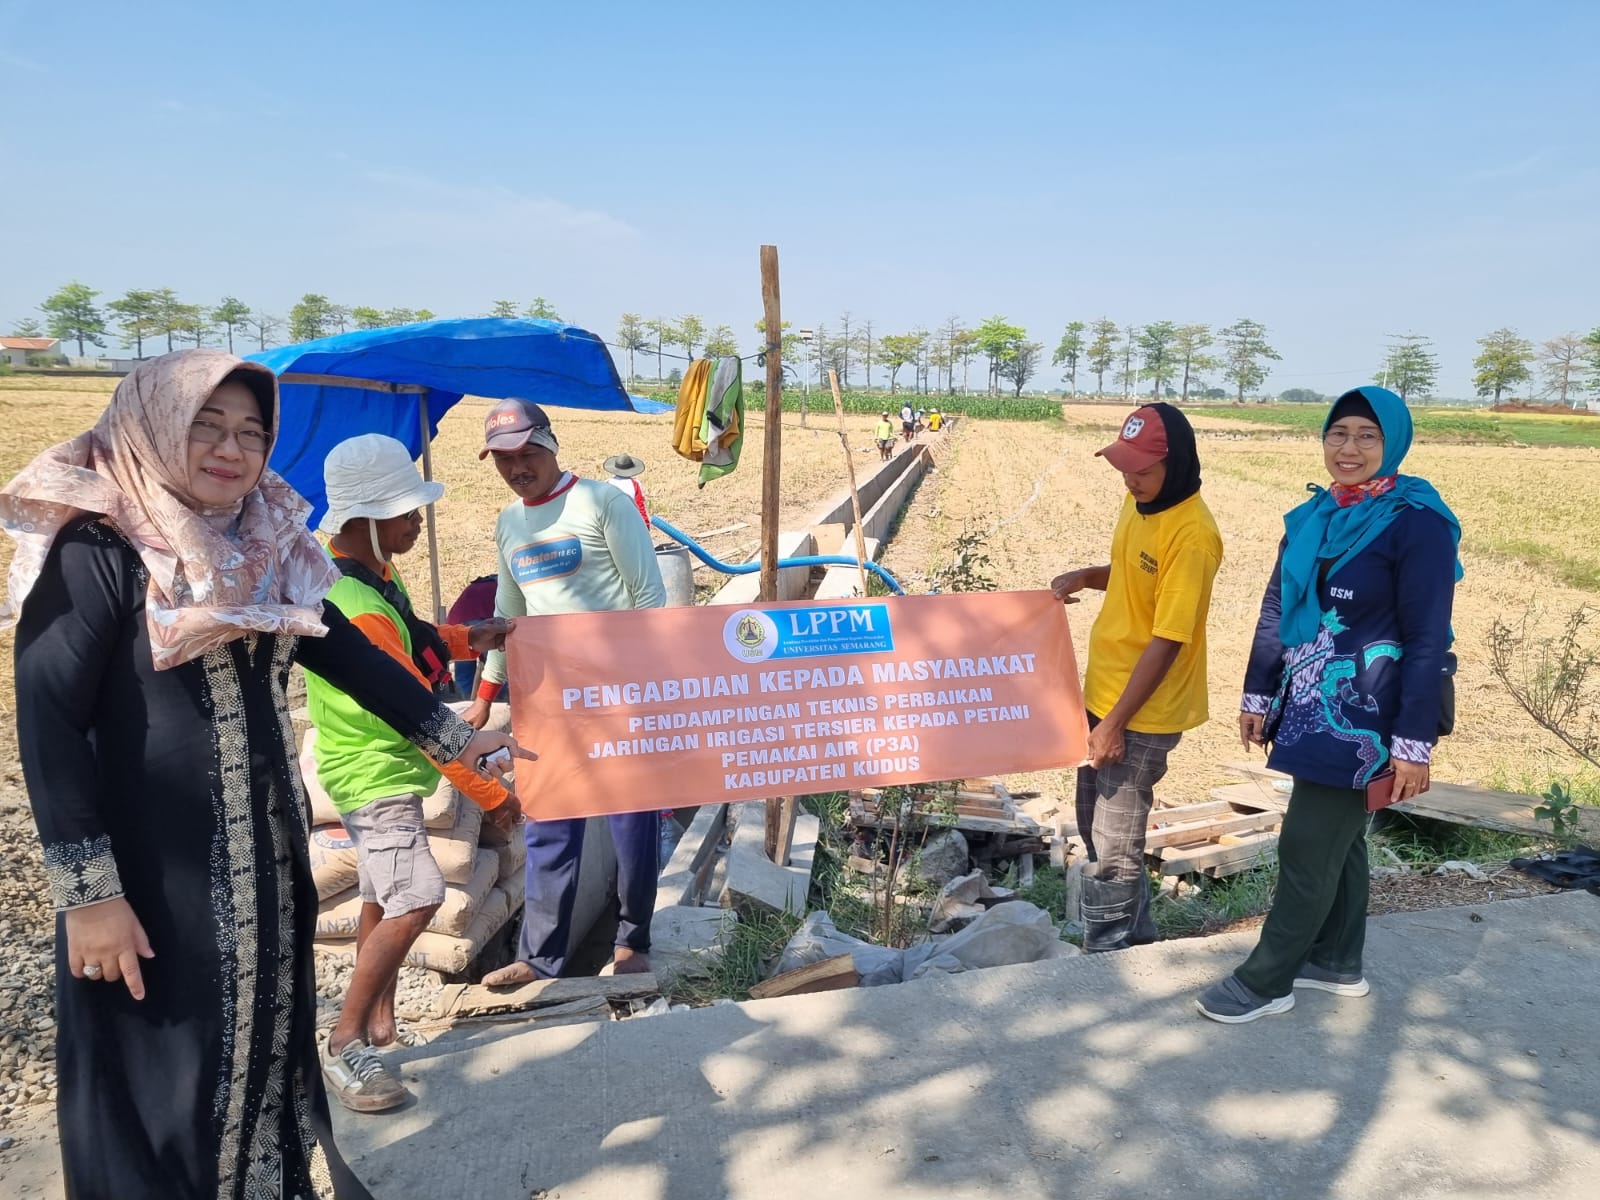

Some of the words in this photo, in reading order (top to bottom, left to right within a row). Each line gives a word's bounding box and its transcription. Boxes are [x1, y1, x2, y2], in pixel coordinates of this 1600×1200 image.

[1330, 586, 1354, 600] USM
[789, 609, 874, 636] LPPM
[783, 643, 838, 655] UNIVERSITAS
[840, 640, 887, 650] SEMARANG
[562, 674, 749, 710] PENGABDIAN
[759, 665, 865, 693] KEPADA
[872, 653, 1036, 684] MASYARAKAT
[629, 703, 800, 733] PENDAMPINGAN
[807, 695, 879, 715] TEKNIS
[885, 687, 993, 710] PERBAIKAN
[588, 734, 699, 759] JARINGAN
[706, 724, 785, 748] IRIGASI
[791, 717, 877, 739] TERSIER
[883, 710, 959, 731] KEPADA
[964, 704, 1030, 724] PETANI
[721, 745, 816, 768] PEMAKAI
[824, 740, 859, 758] AIR
[866, 735, 920, 757] (P3A)
[724, 762, 846, 790] KABUPATEN
[853, 756, 920, 777] KUDUS
